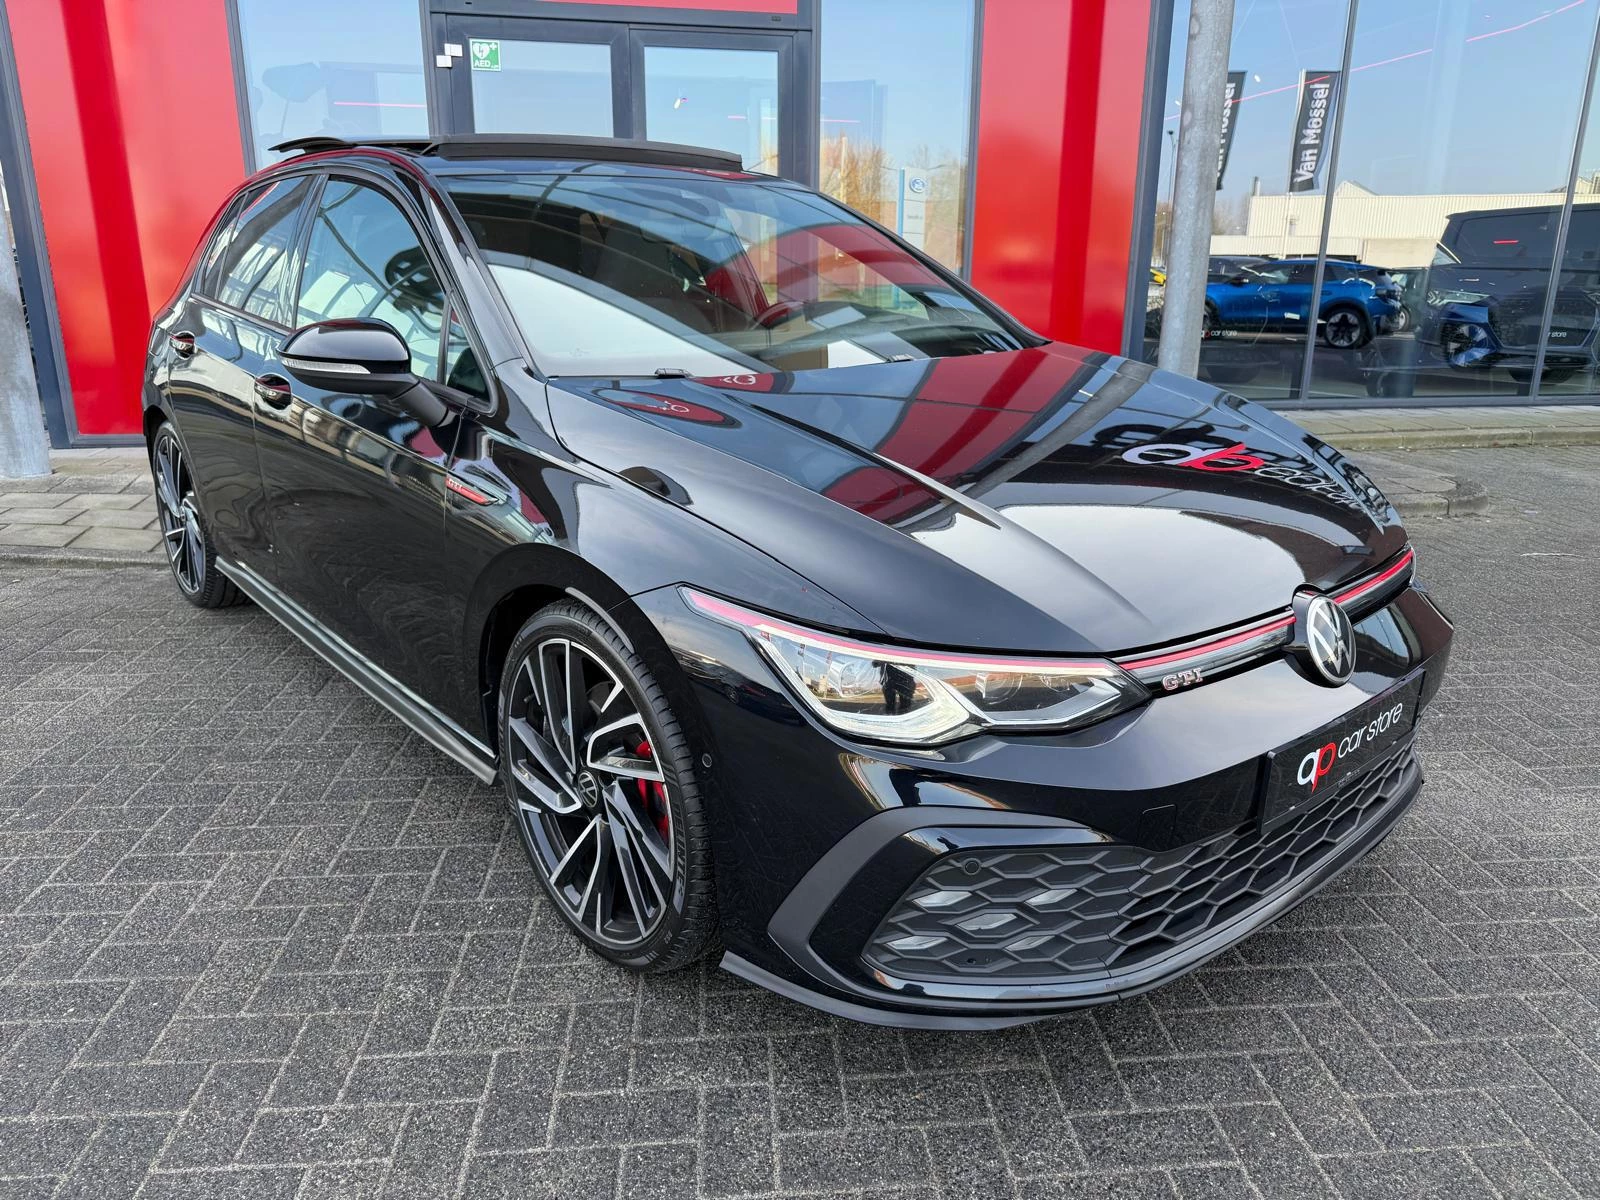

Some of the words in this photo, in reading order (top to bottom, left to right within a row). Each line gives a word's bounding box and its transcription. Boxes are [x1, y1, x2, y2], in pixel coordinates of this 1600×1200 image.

[1301, 84, 1329, 145] Mossel
[1294, 149, 1318, 182] Van
[1162, 669, 1203, 691] GTI
[1338, 725, 1366, 758] car
[1366, 703, 1403, 741] store
